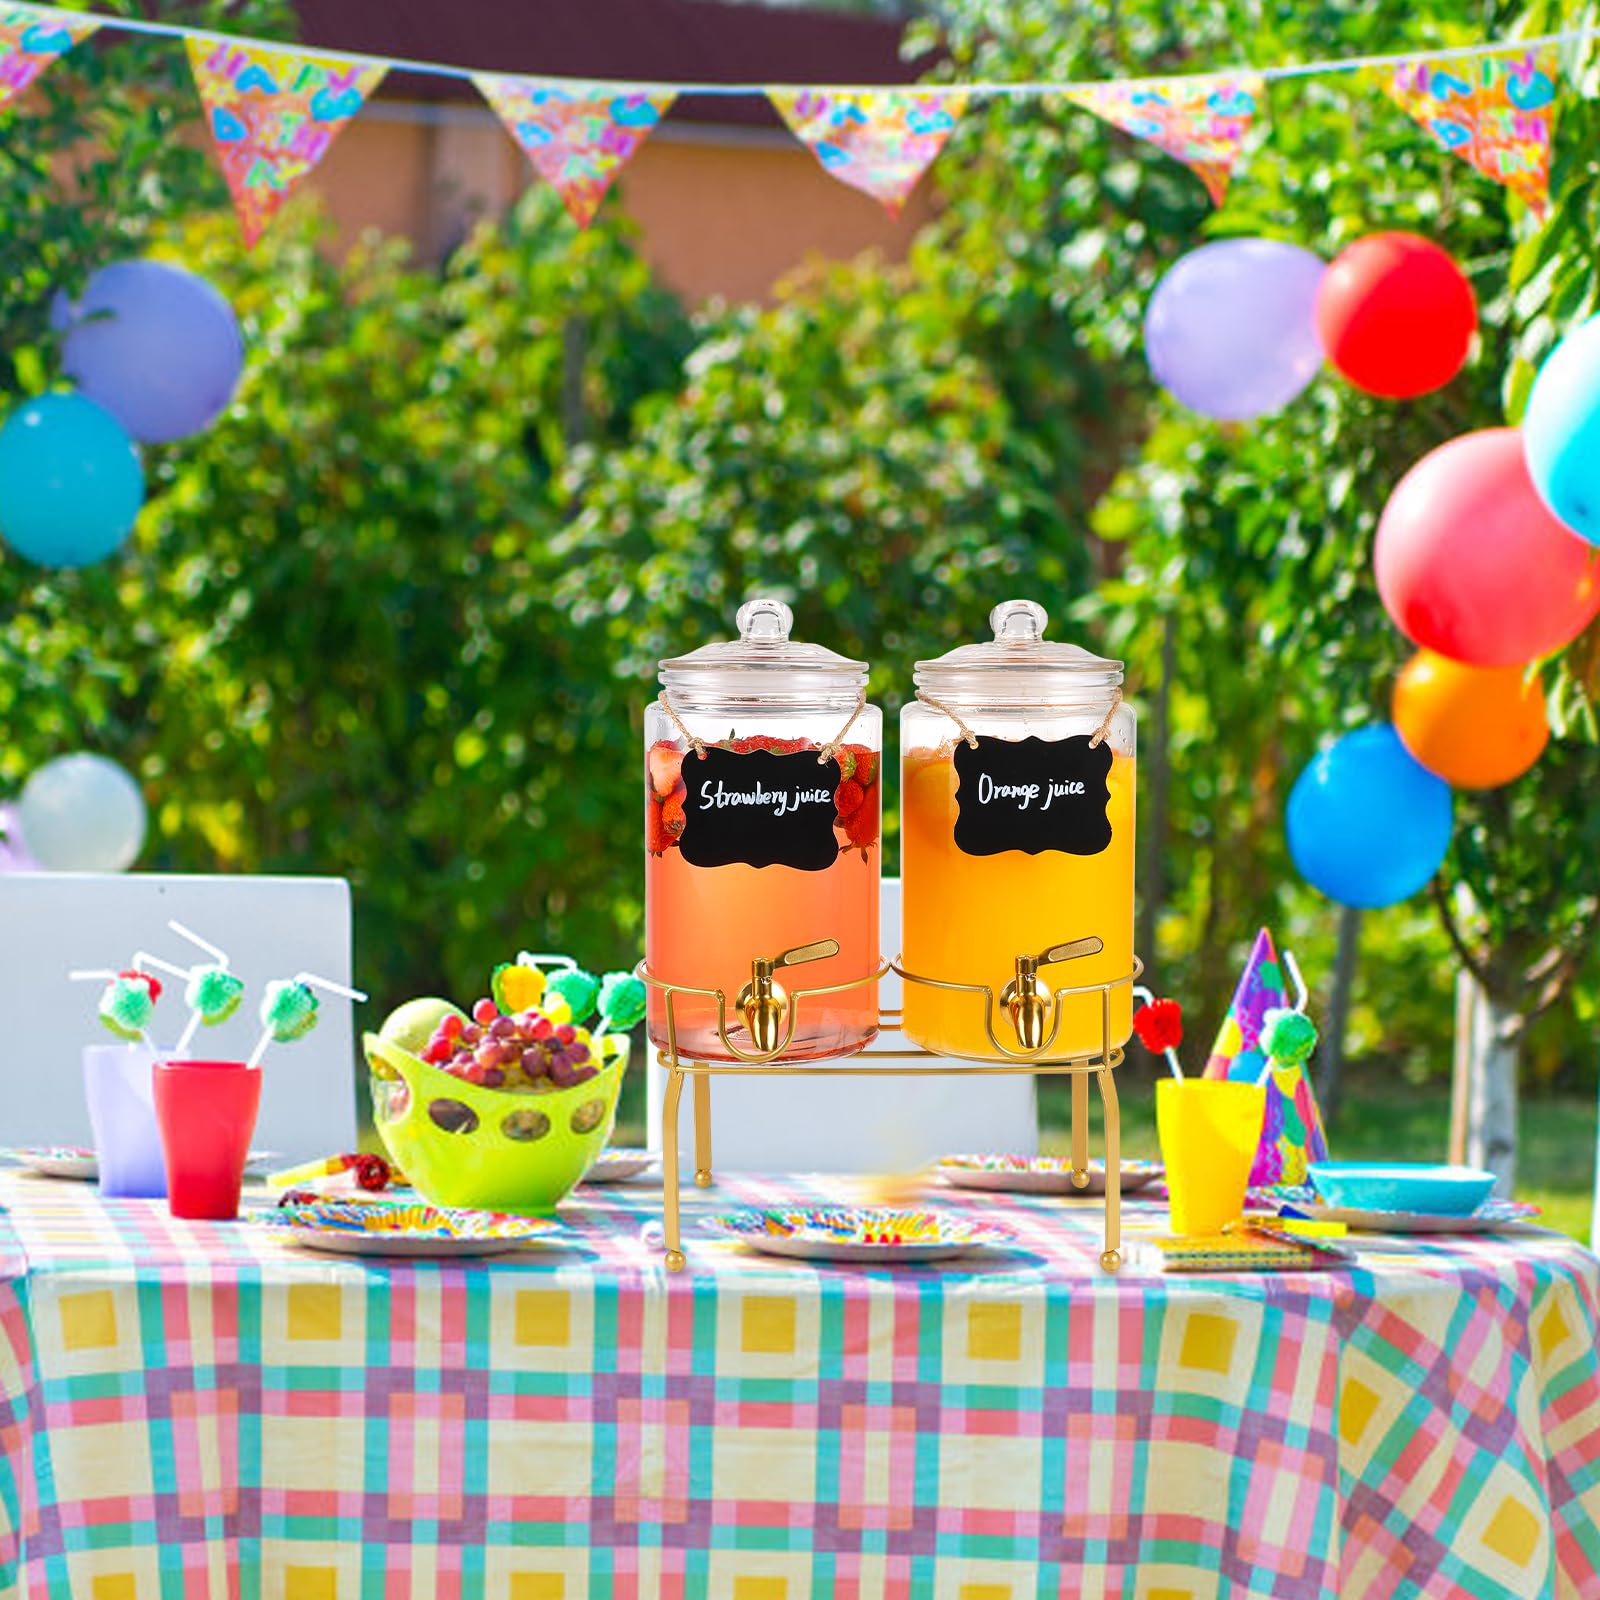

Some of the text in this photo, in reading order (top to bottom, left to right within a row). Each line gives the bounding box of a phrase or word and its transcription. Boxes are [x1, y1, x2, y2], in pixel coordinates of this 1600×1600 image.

[786, 785, 832, 812] juice
[978, 772, 1086, 811] Orange juice
